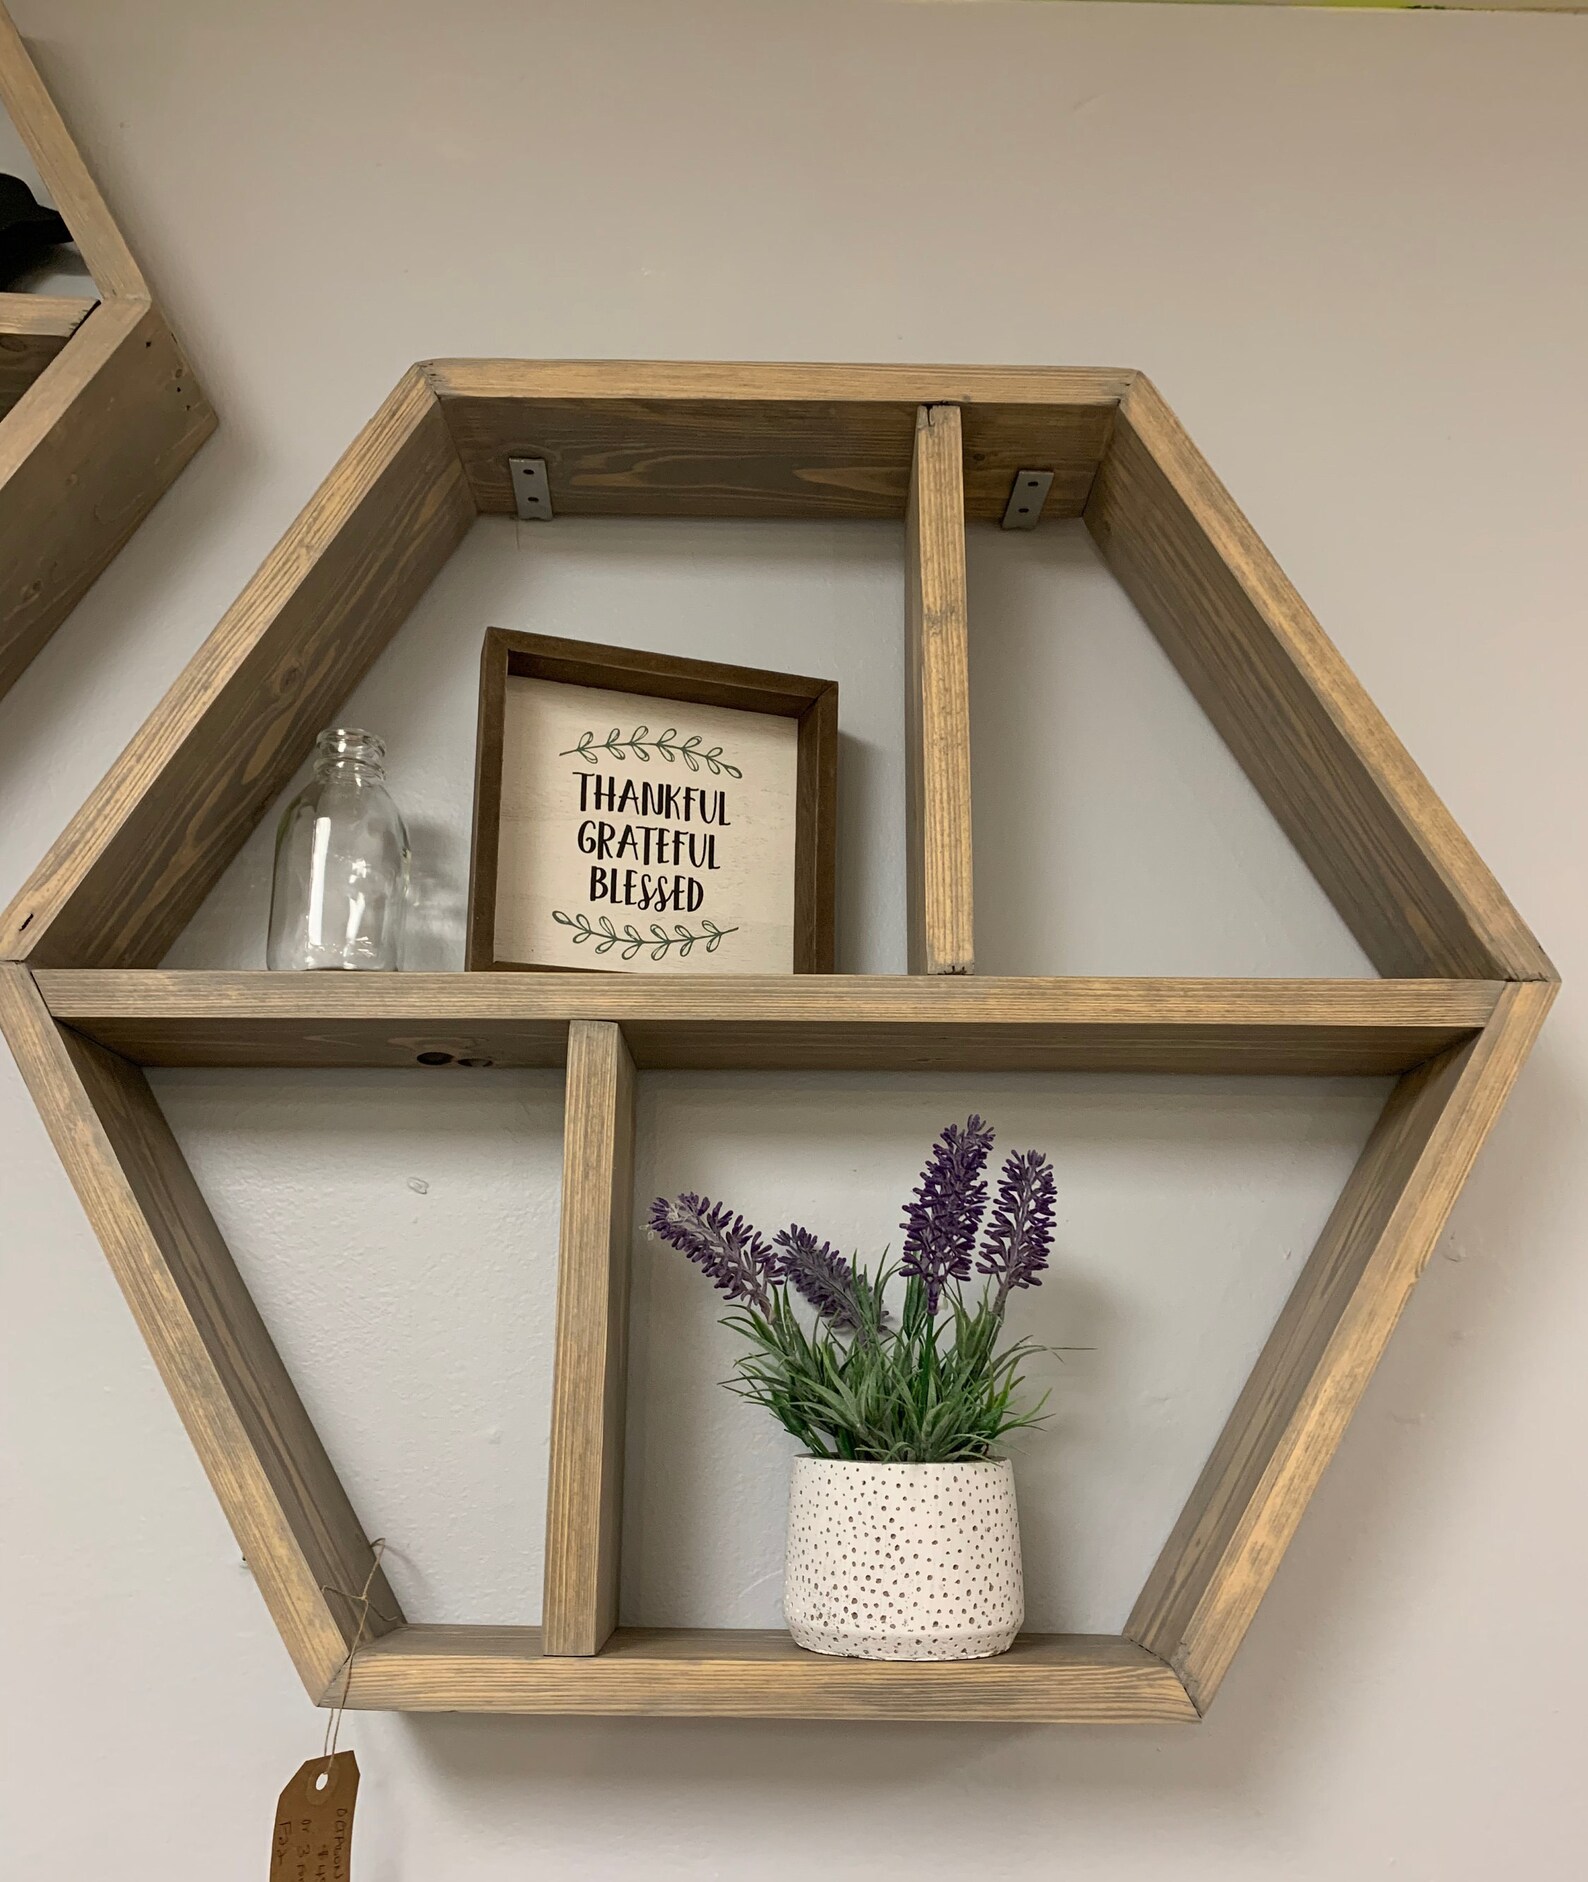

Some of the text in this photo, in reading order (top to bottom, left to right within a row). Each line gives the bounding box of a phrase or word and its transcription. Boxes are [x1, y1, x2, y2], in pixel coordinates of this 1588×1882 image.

[572, 771, 731, 826] THANKFUL
[577, 820, 720, 870] GRATEFUL
[590, 866, 704, 912] BLESSED
